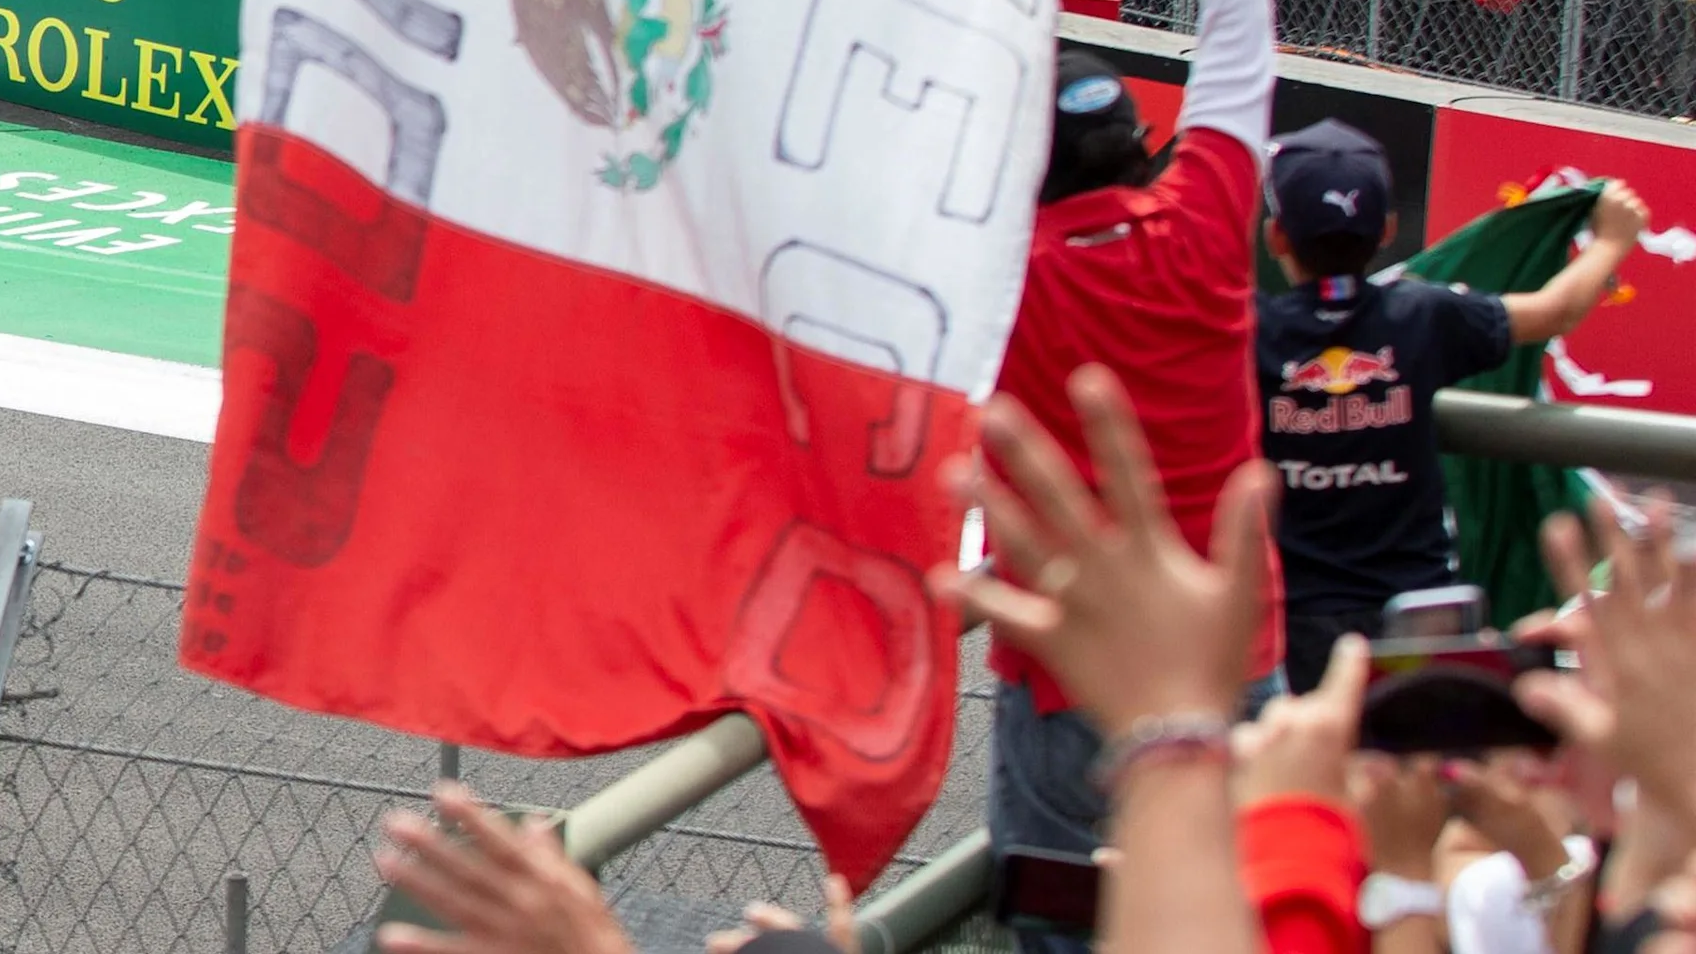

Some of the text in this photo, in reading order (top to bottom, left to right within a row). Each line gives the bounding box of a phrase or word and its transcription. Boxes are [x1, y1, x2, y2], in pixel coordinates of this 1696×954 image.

[1268, 383, 1414, 435] Red Bull
[1276, 459, 1409, 491] TOTAL
